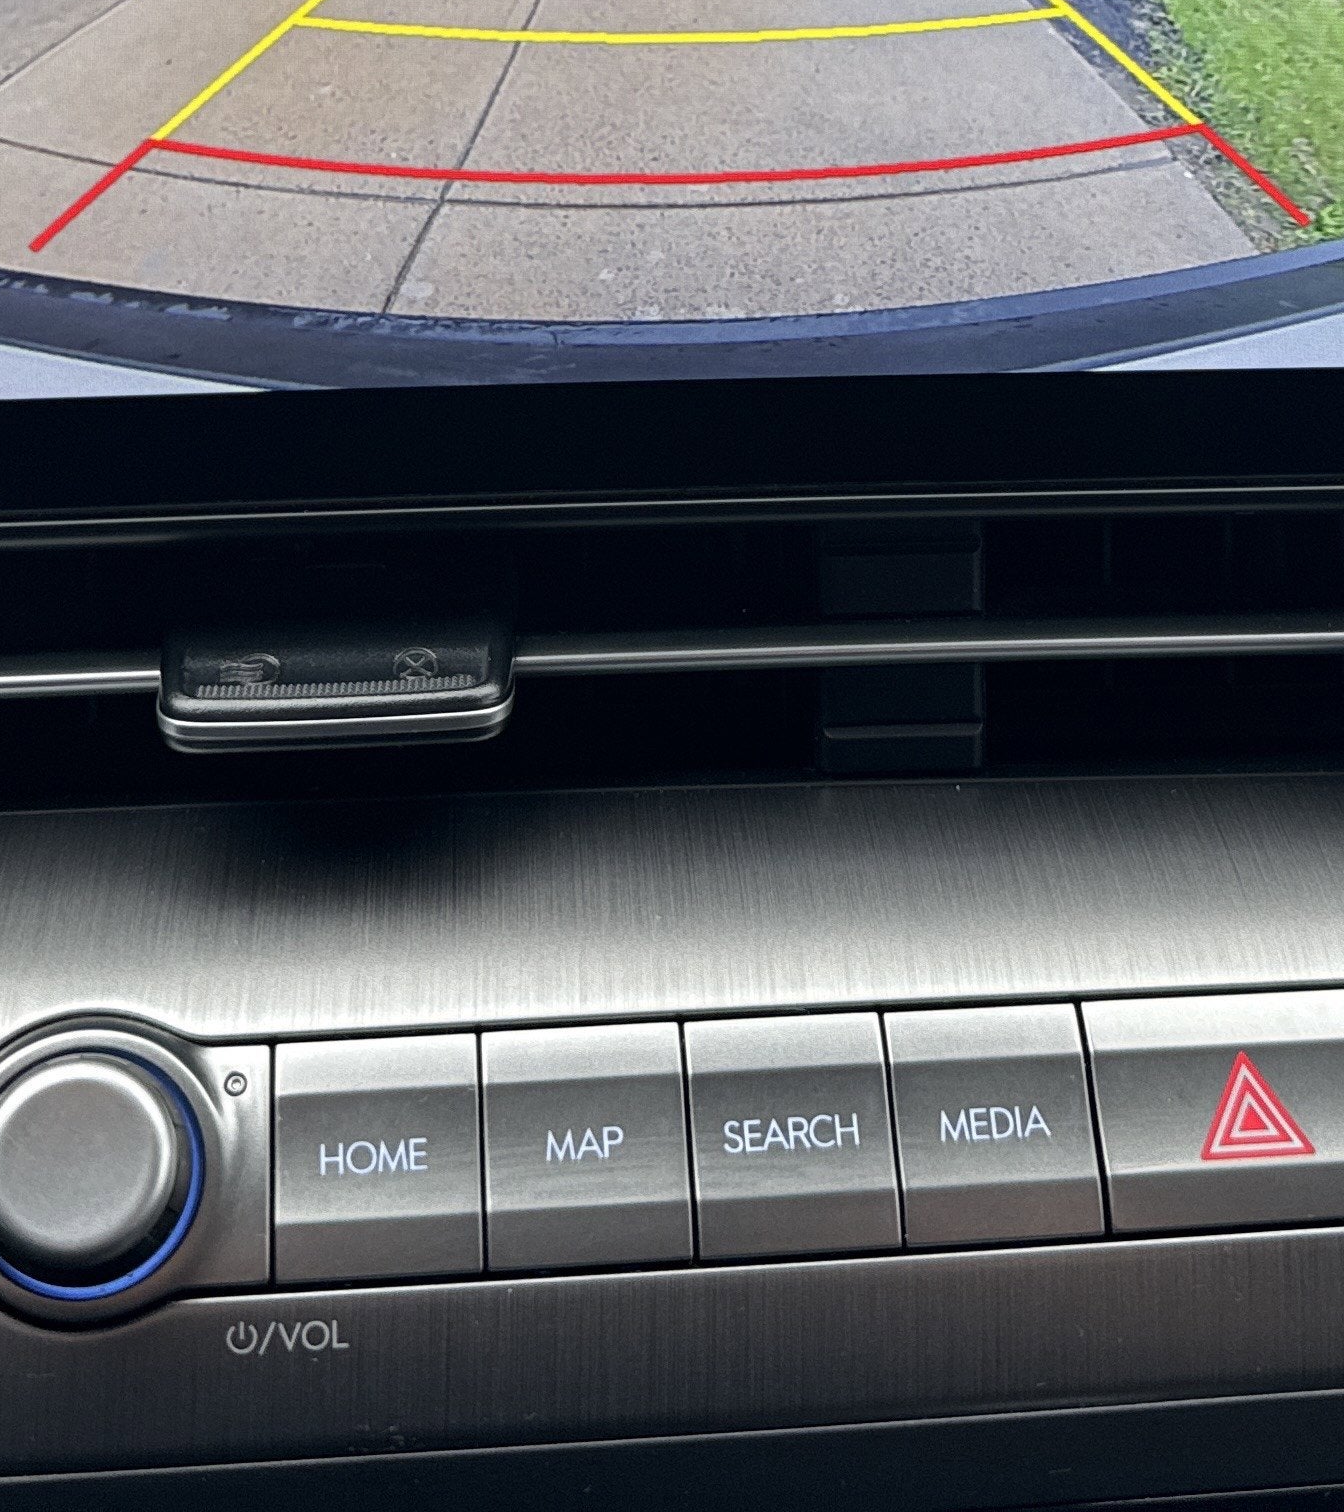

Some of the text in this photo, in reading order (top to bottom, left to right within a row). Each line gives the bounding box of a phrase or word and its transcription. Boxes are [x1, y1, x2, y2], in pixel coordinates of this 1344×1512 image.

[545, 1125, 625, 1163] MAP
[722, 1112, 860, 1155] SEARCH
[939, 1104, 1052, 1144] MEDIA
[318, 1136, 430, 1177] HOME
